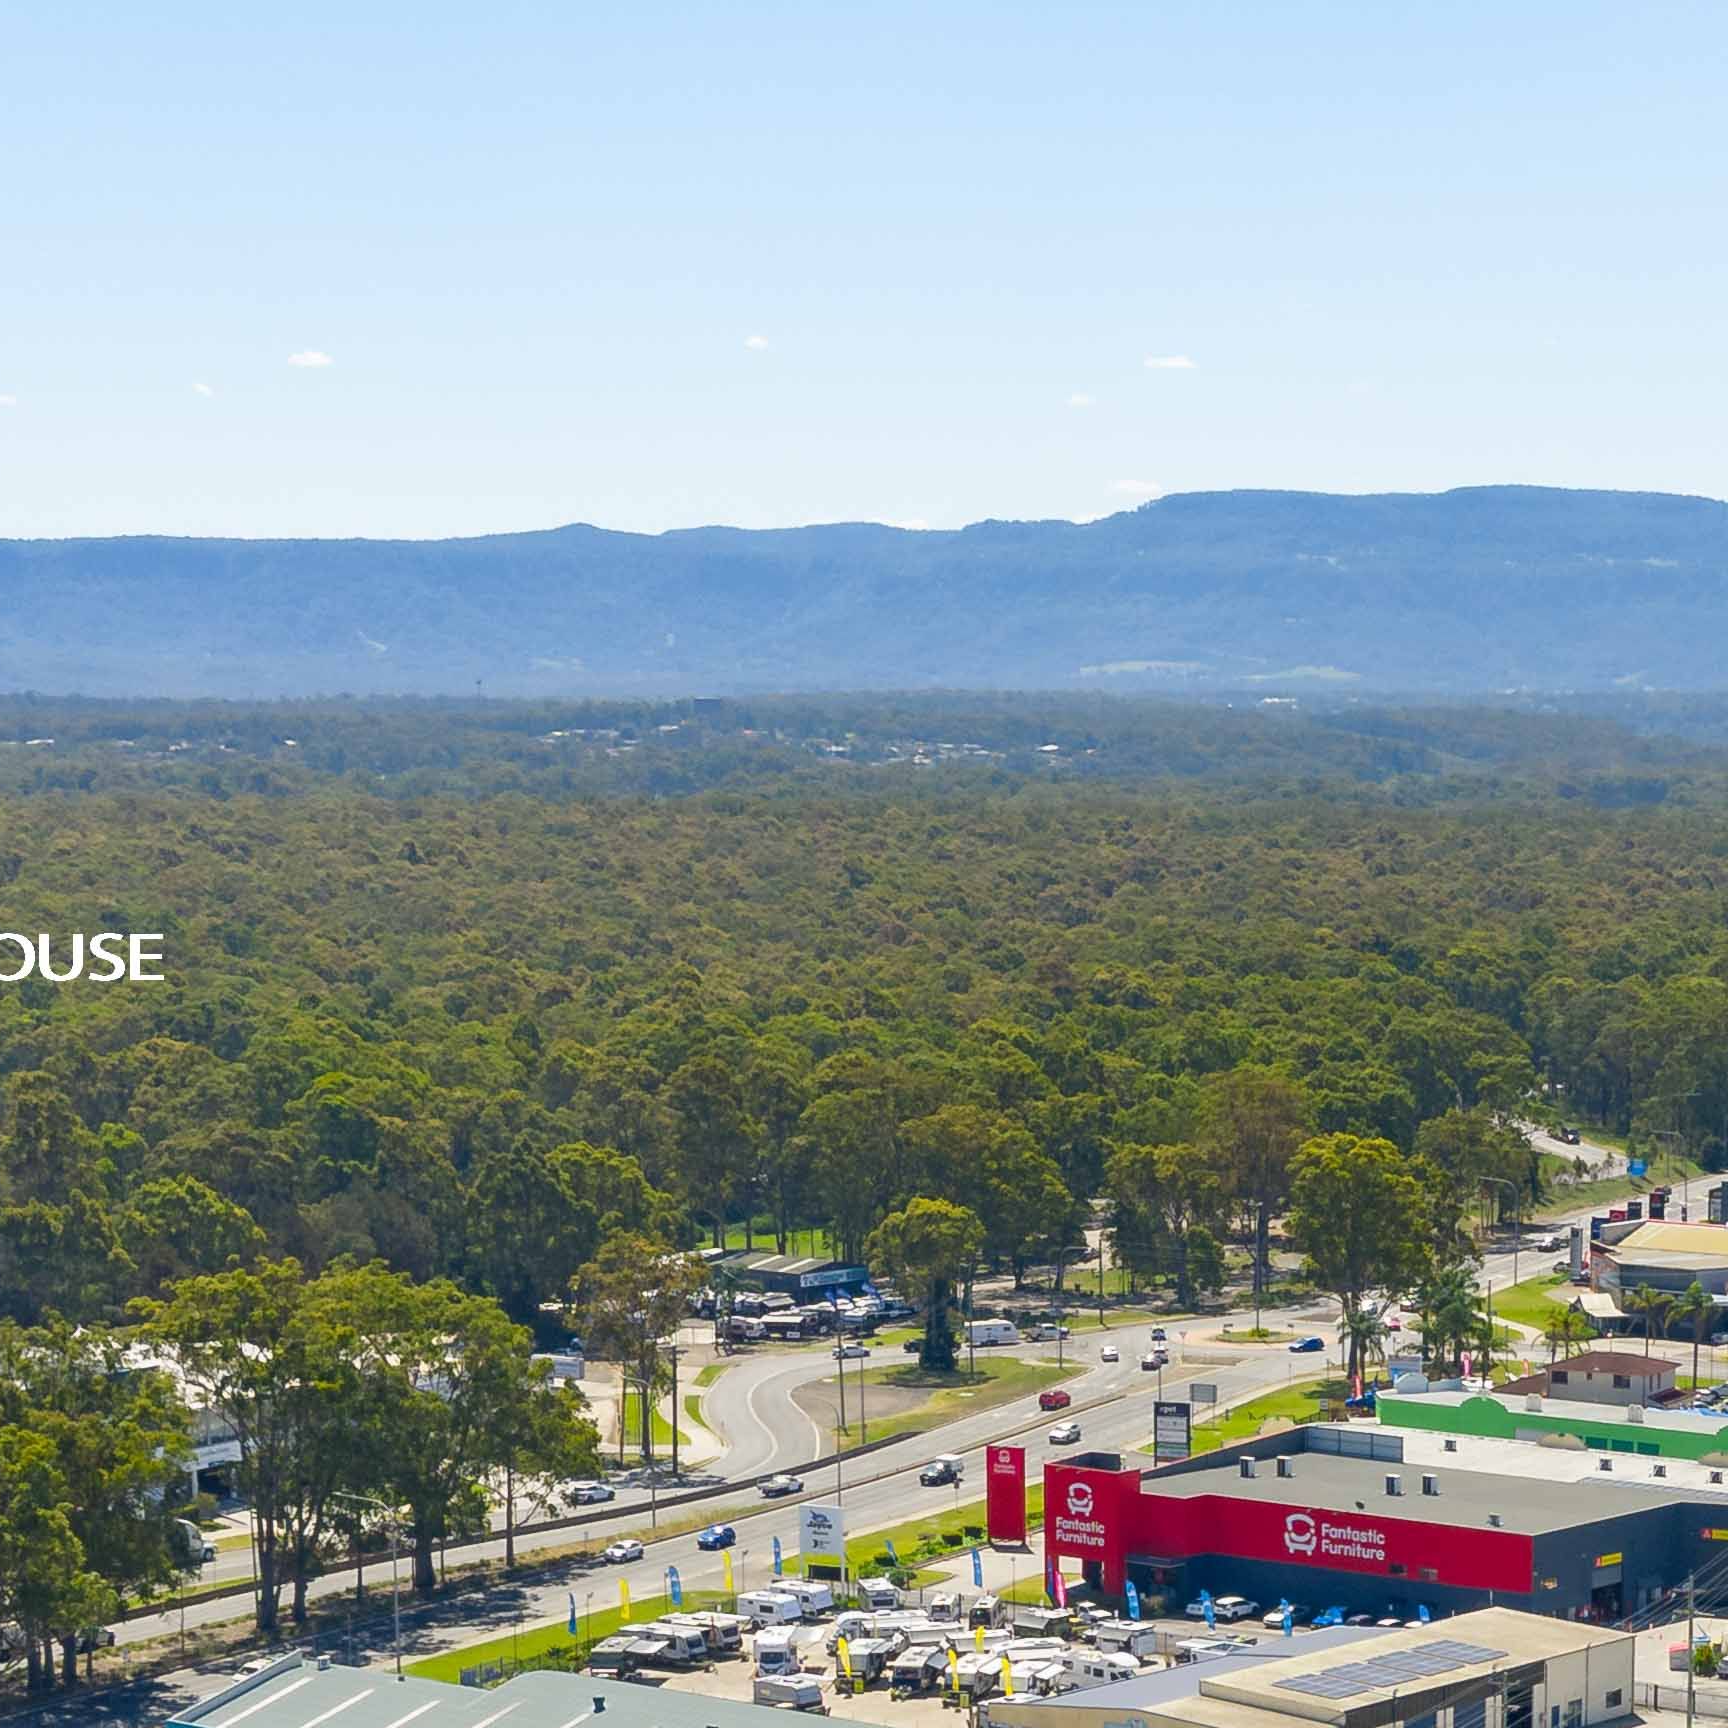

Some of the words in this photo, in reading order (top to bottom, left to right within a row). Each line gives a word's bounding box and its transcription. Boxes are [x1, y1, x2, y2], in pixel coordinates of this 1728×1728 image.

[1055, 1516, 1105, 1535] Fantastic
[1321, 1523, 1386, 1545] Fantastic
[1055, 1530, 1105, 1547] Furniture
[1321, 1539, 1385, 1561] Furniture
